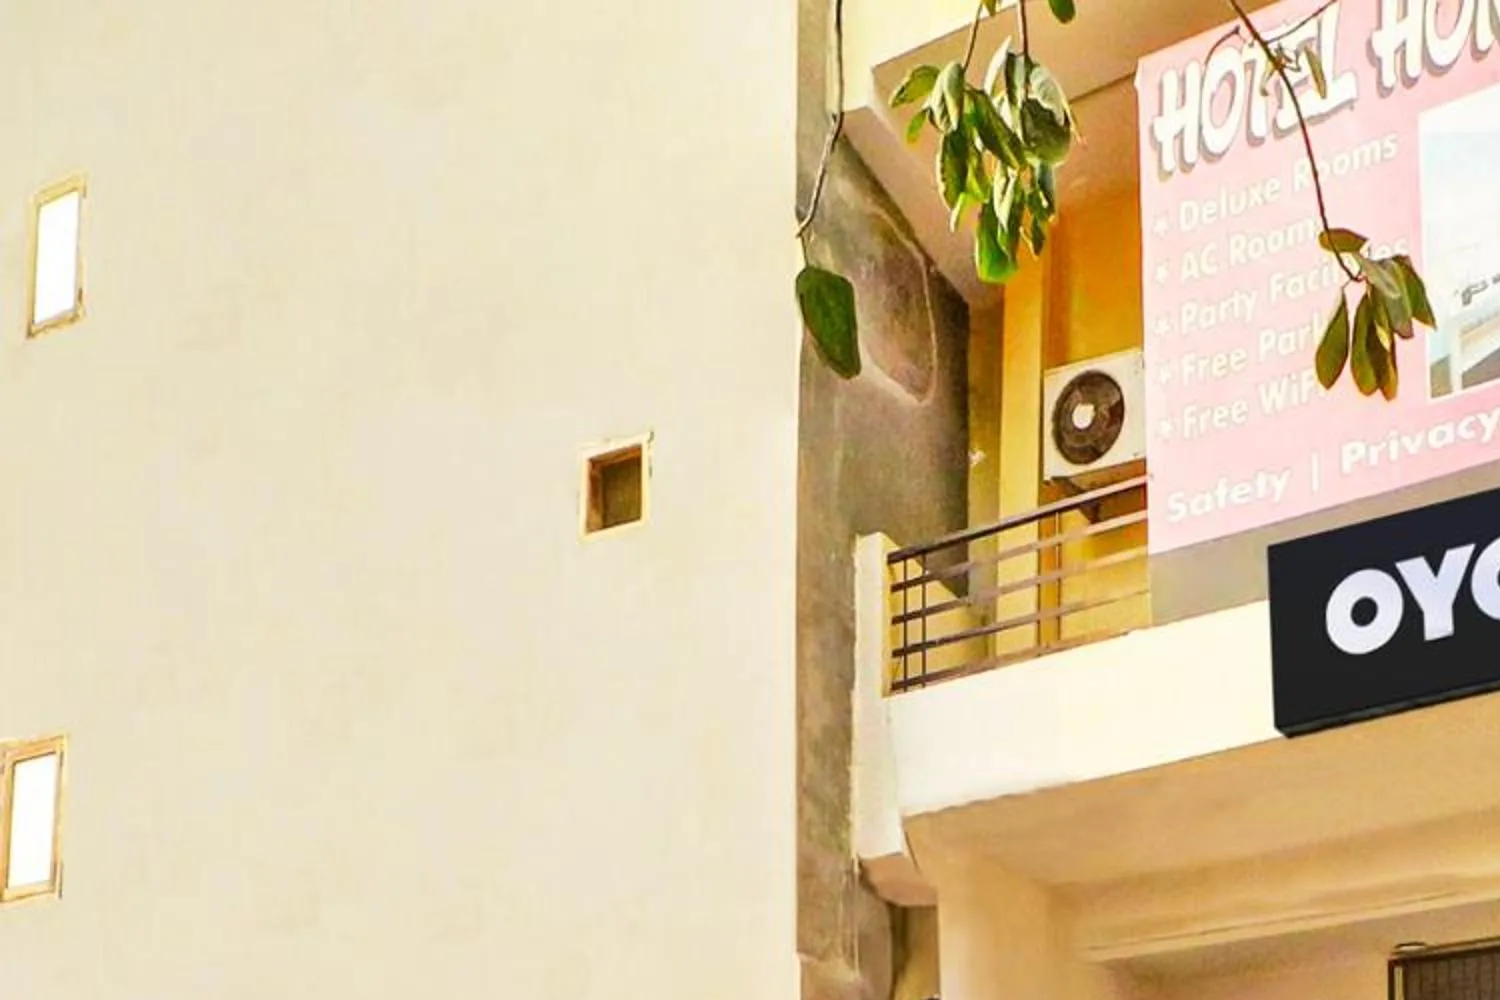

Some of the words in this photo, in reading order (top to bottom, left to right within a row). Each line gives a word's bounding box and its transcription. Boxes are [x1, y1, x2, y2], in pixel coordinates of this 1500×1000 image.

[1150, 0, 1358, 181] HOTEL
[1178, 176, 1282, 232] Deluxe
[1293, 131, 1399, 192] Rooms
[1179, 241, 1219, 281] AC
[1180, 288, 1259, 335] Party
[1269, 235, 1409, 304] Facilies
[1181, 347, 1249, 388] Free
[1183, 400, 1250, 440] Free
[1257, 367, 1324, 416] WiF
[1166, 468, 1291, 524] Safety
